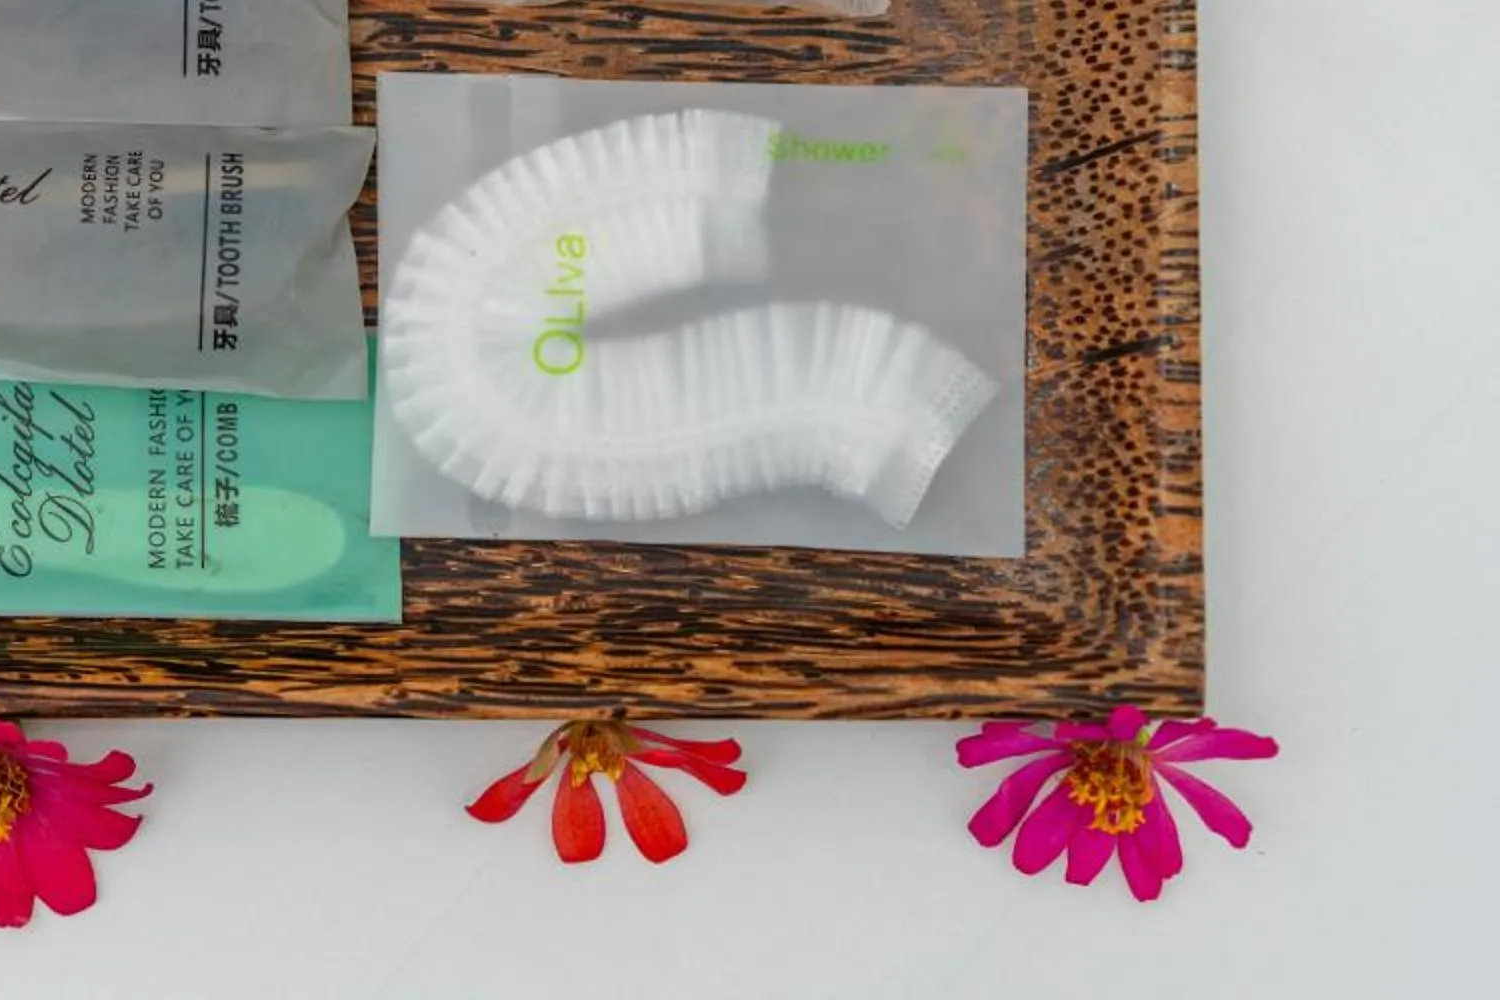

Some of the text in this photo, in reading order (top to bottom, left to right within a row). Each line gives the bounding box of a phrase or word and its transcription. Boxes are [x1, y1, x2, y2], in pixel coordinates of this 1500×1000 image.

[80, 153, 97, 225] MODERN
[103, 154, 120, 226] FASHION
[124, 150, 143, 233] TAKE CARE
[147, 159, 165, 221] OF YOU
[219, 151, 245, 216] BRUSH
[176, 415, 195, 442] OF
[147, 388, 168, 570] MODERN FASHI
[176, 452, 195, 507] CARE
[175, 518, 195, 569] TAKE
